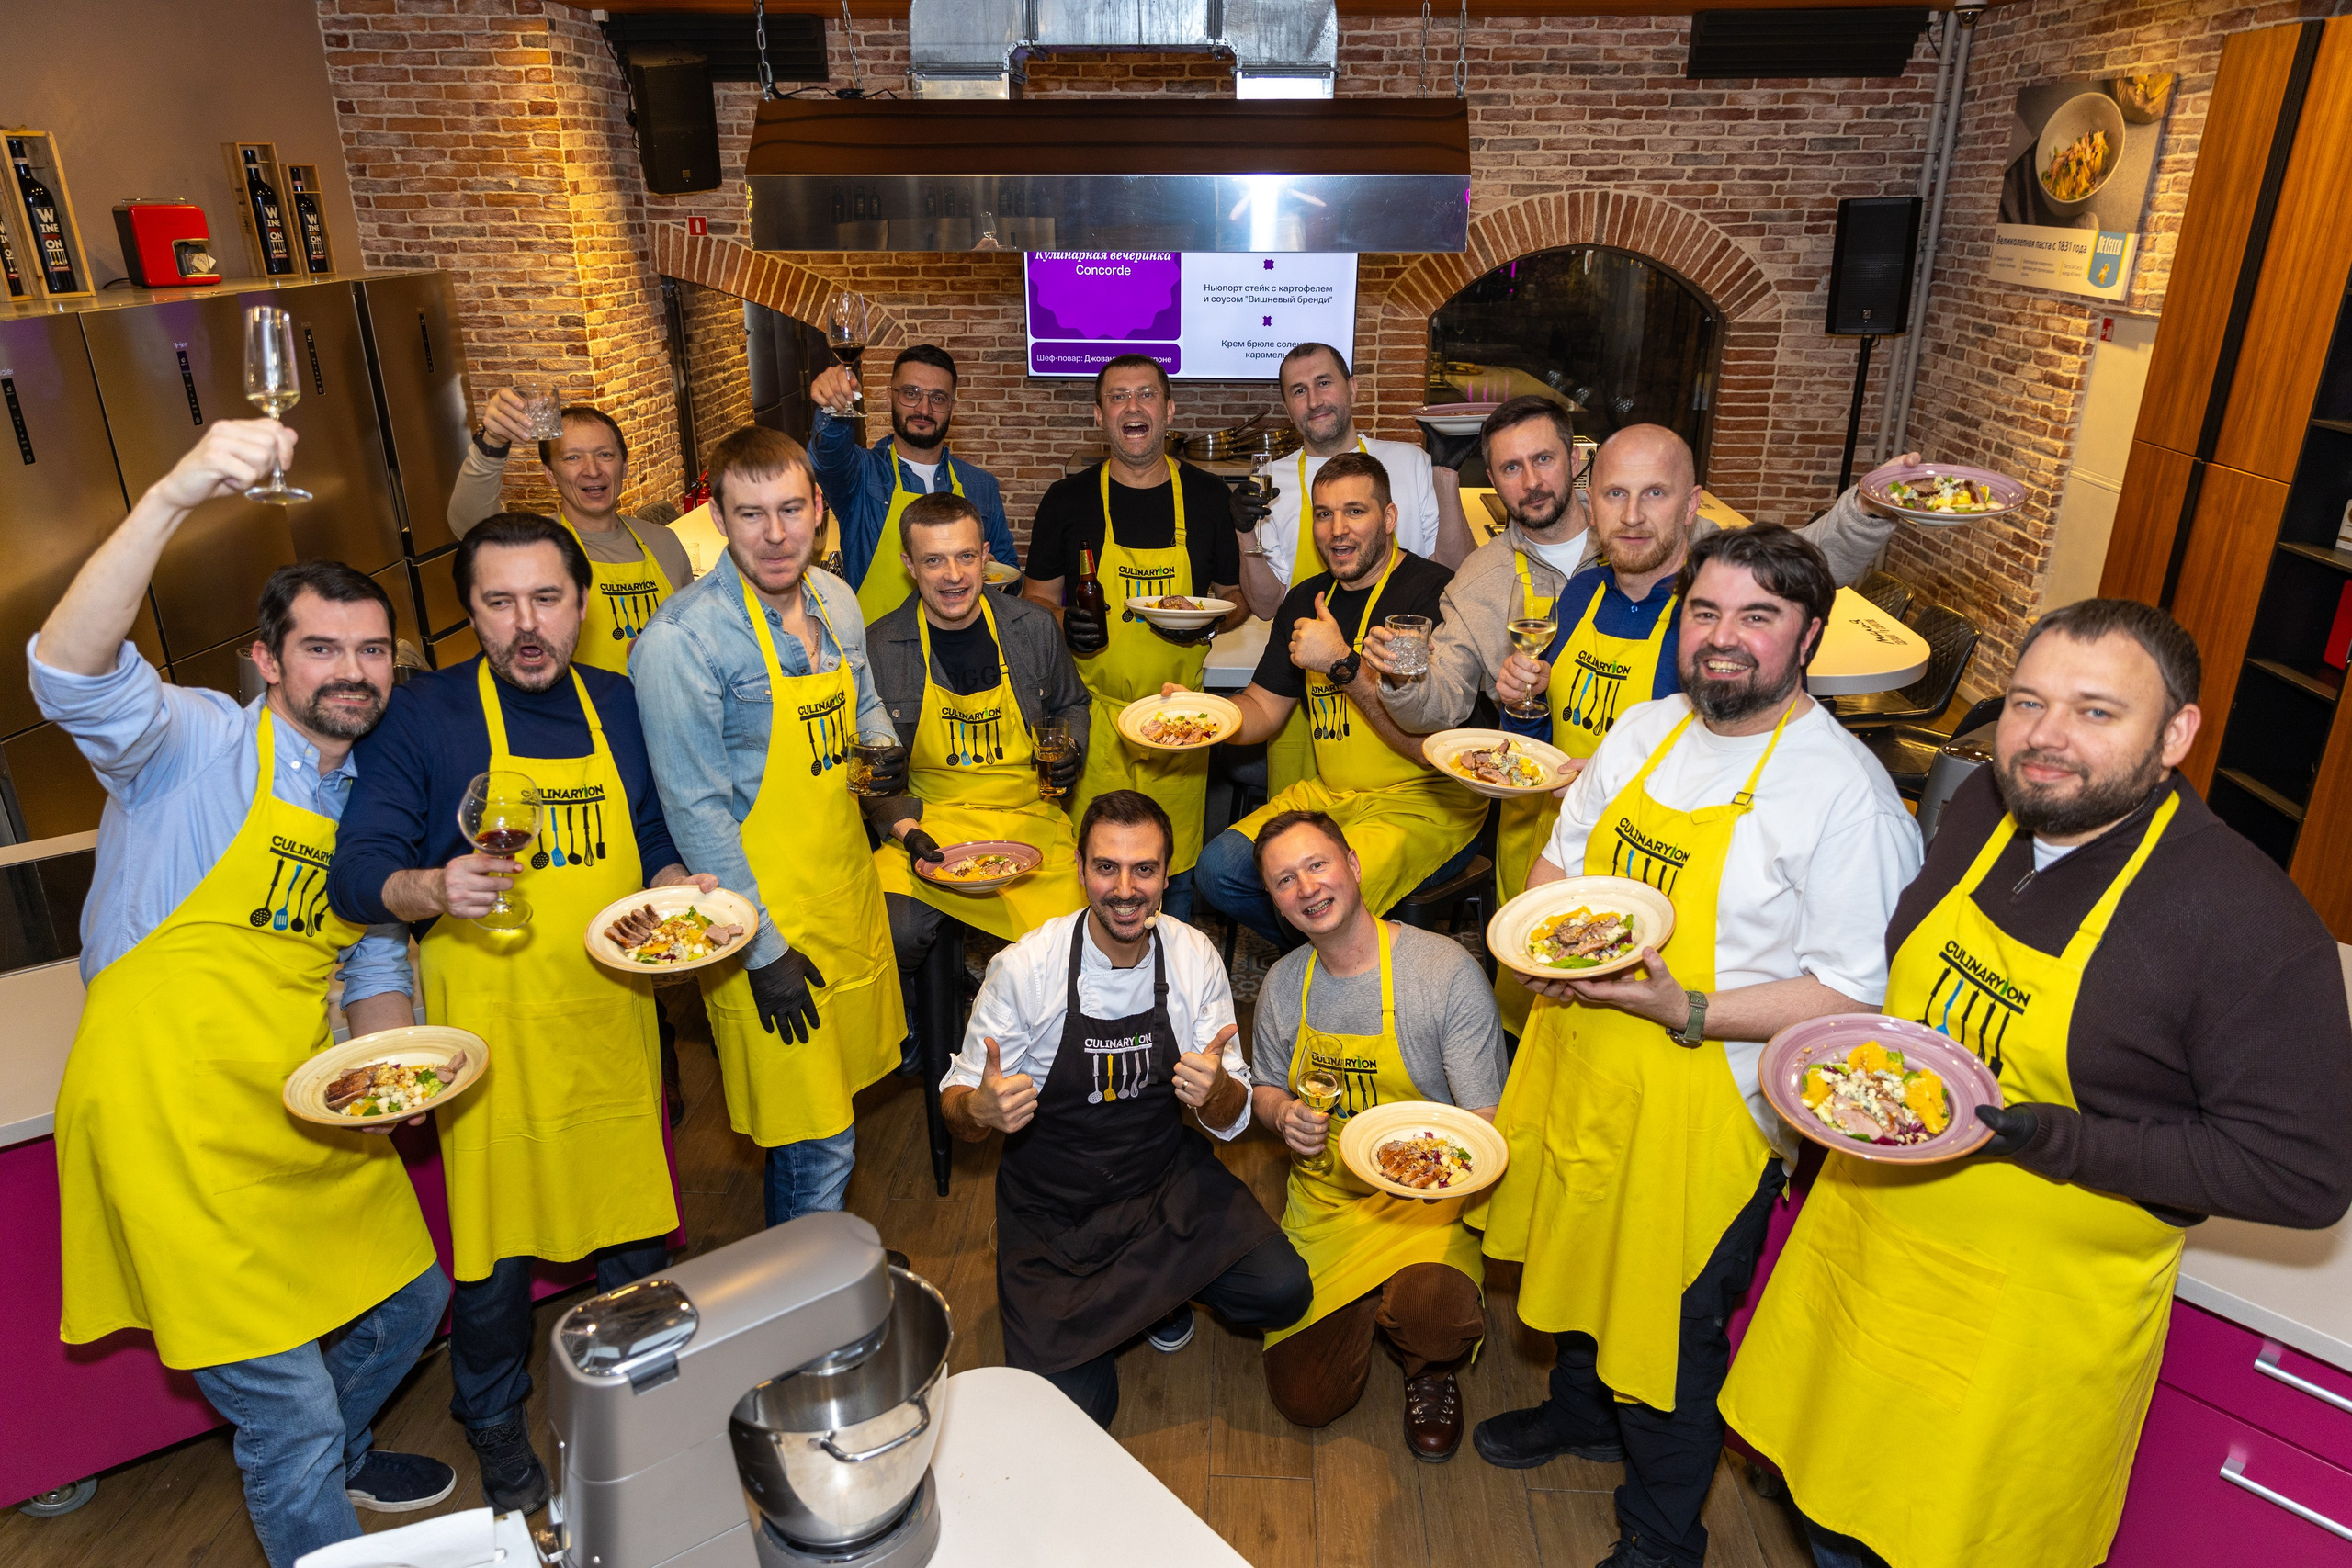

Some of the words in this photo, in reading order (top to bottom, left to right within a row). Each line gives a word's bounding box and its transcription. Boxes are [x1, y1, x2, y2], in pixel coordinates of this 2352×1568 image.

[269, 231, 283, 240] ON
[45, 239, 63, 249] ON
[1996, 235, 2035, 247] Великолепная
[2035, 240, 2052, 250] паста
[2058, 240, 2073, 253] 1831
[2073, 243, 2087, 256] года
[1035, 251, 1107, 263] Кулинарная
[1110, 252, 1171, 263] вечеринка
[1076, 265, 1131, 276] Concorde
[1204, 284, 1242, 293] Ньюпорт
[1245, 284, 1270, 292] стейк
[1278, 285, 1333, 293] картофелем
[1245, 295, 1295, 303] "Вишневый
[1297, 296, 1333, 304] бренди"
[1221, 340, 1245, 349] Крем
[1247, 340, 1274, 349] брюле
[1036, 354, 1083, 364] Шеф-повар:
